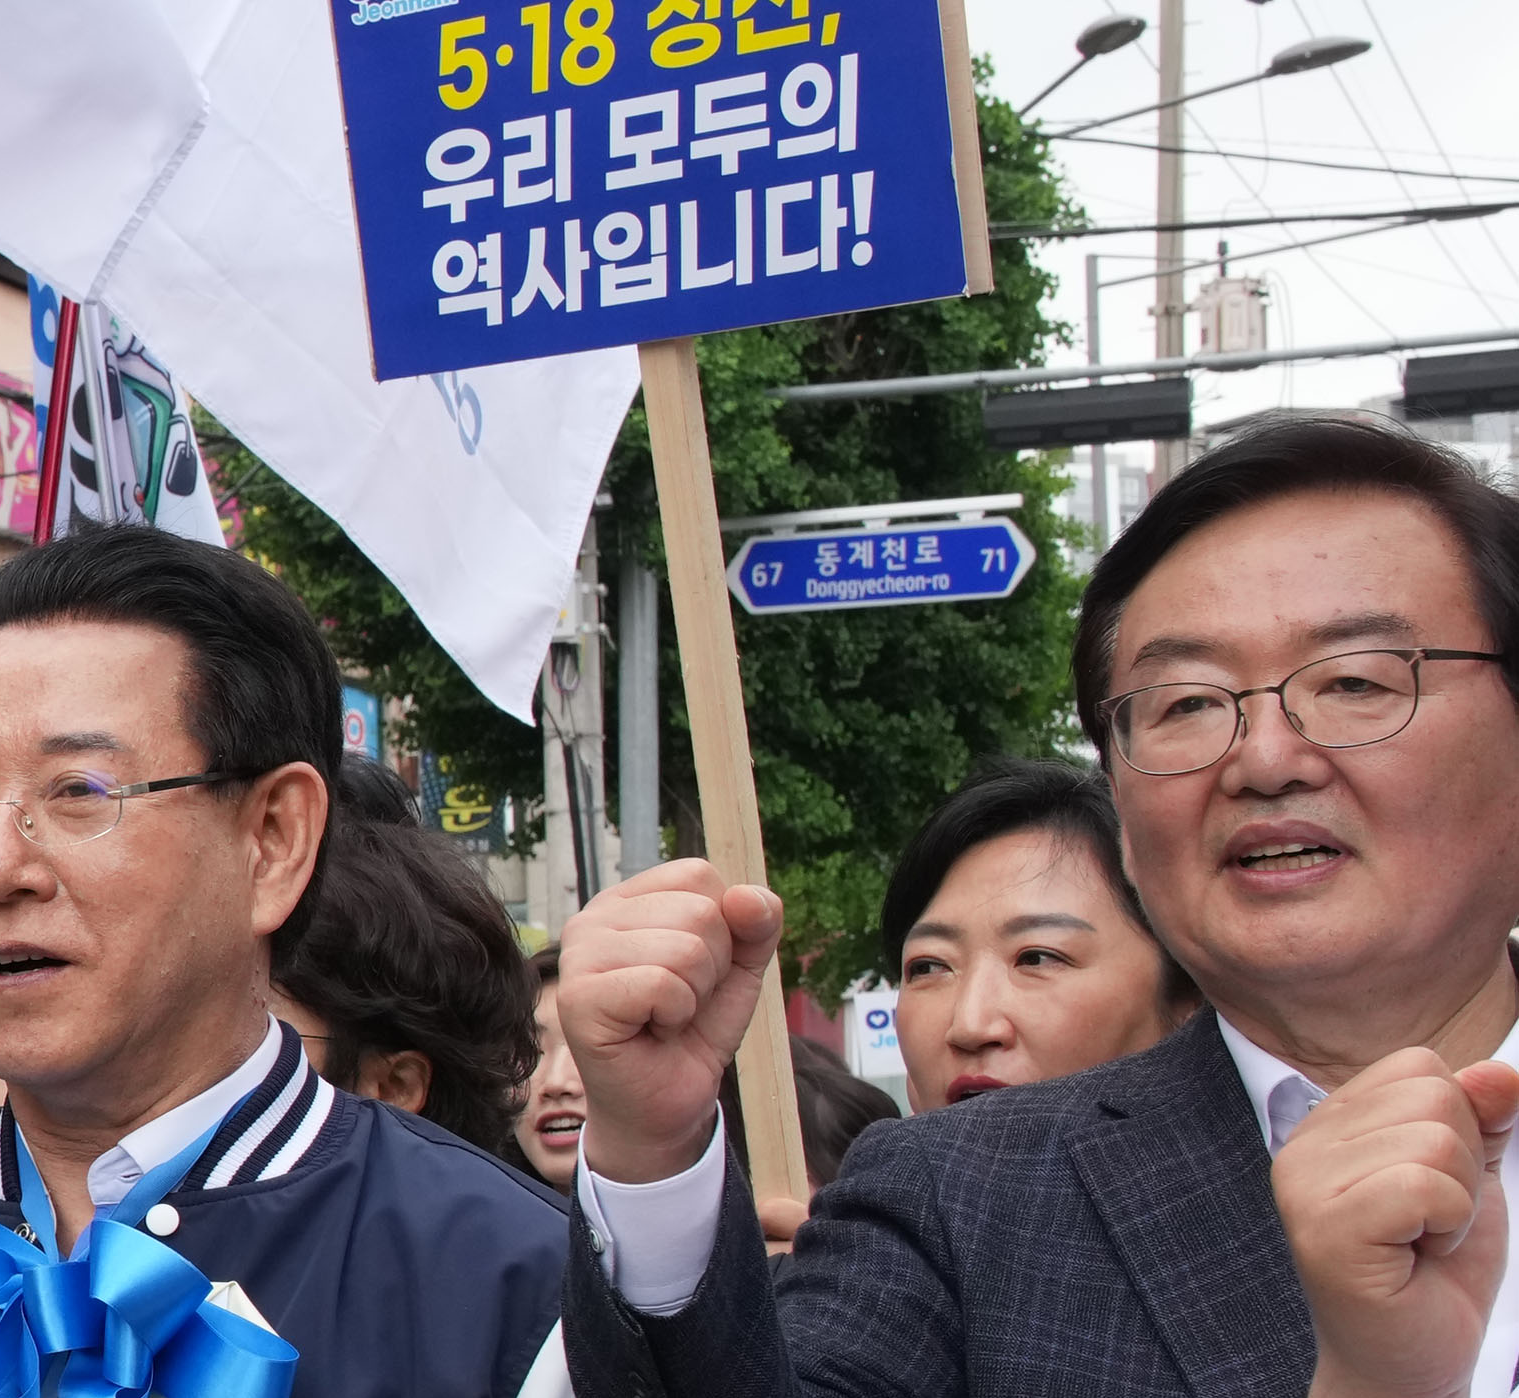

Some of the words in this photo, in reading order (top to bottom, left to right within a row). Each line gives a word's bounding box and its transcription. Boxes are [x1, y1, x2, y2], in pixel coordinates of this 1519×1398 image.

[351, 0, 459, 25] Jeonna
[422, 107, 572, 224] 우리
[605, 52, 859, 191] 모두의
[431, 170, 875, 327] 역사입니다!
[814, 535, 943, 577] 동계천로
[979, 547, 1007, 573] 71
[751, 562, 783, 587] 67
[805, 572, 951, 599] Donggyecheon-ro
